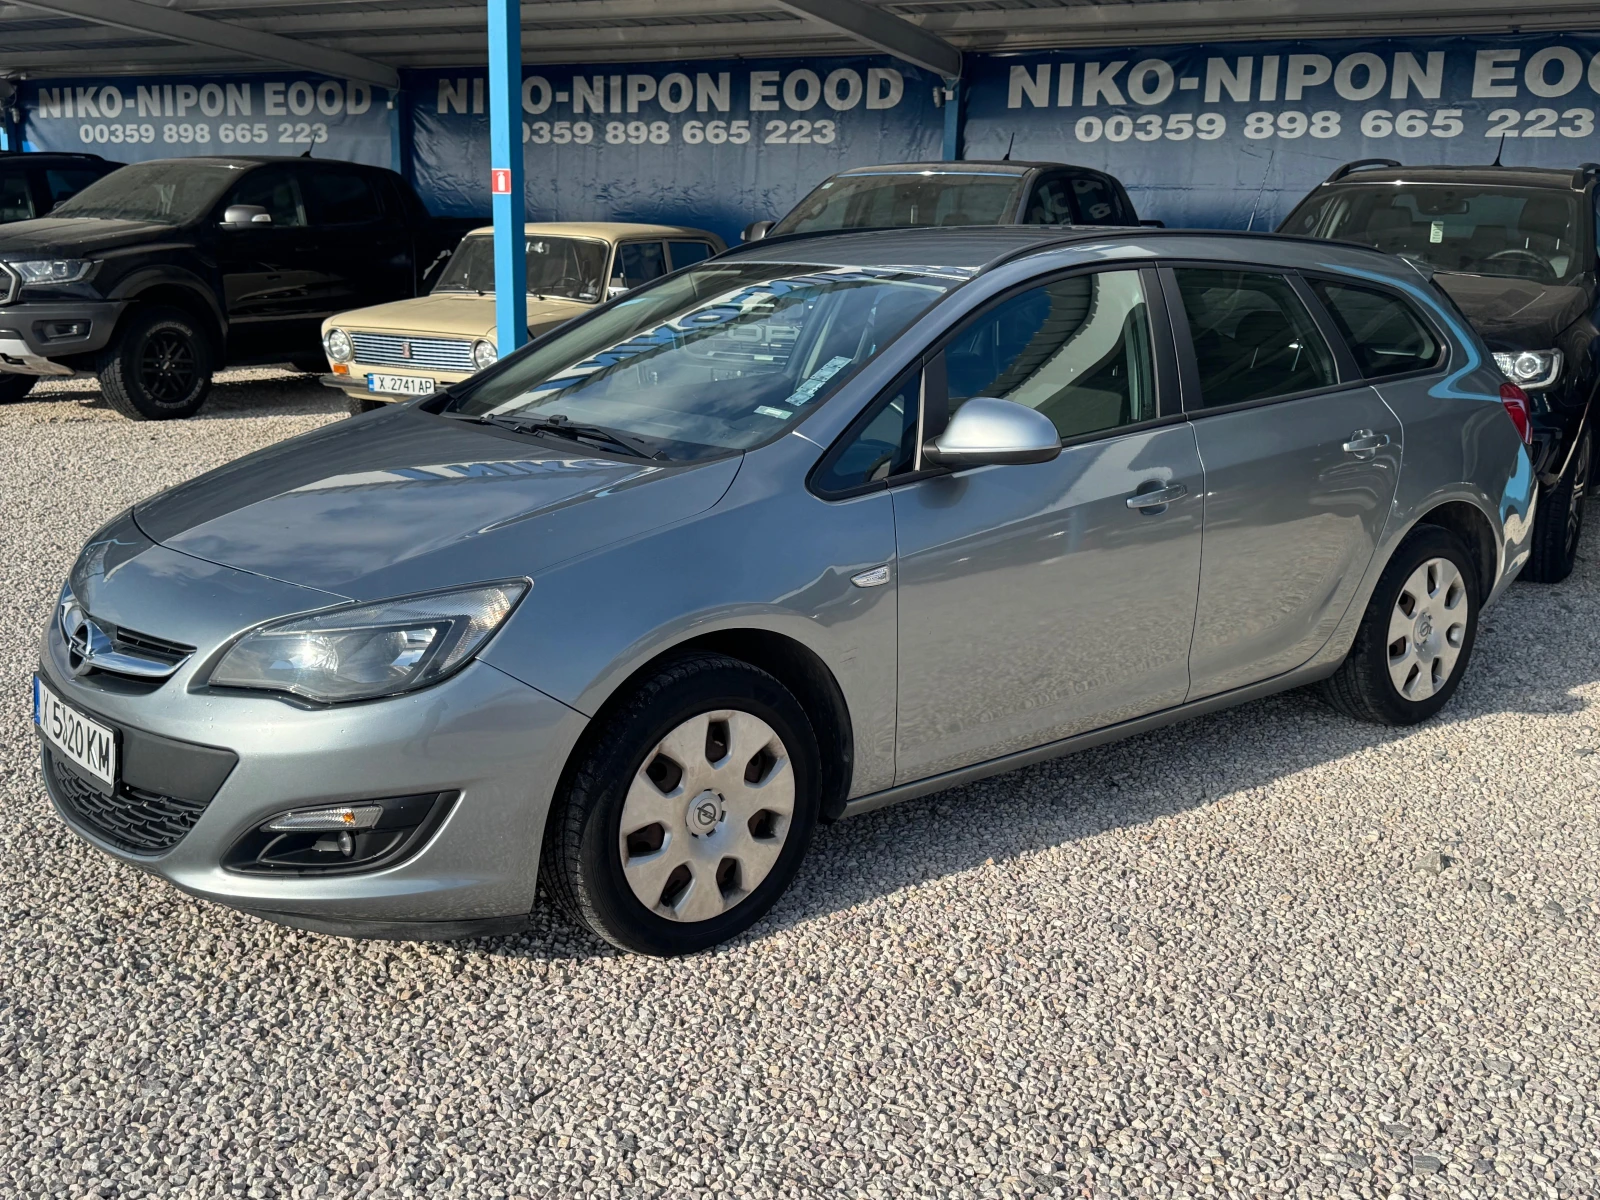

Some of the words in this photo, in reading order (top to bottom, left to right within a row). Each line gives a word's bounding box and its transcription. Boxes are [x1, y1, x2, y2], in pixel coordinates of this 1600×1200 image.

[437, 72, 731, 115] NIO-NIPON
[749, 67, 904, 111] EOOD
[1007, 51, 1445, 109] NIKO-NIPON
[1471, 46, 1600, 98] EO
[38, 83, 252, 119] NIKO-NIPON
[263, 80, 372, 116] EOOD
[79, 123, 156, 144] 00359
[163, 123, 211, 144] 898
[218, 123, 269, 144] 665
[277, 122, 329, 143] 223
[522, 121, 594, 145] 359
[604, 120, 671, 145] 898
[682, 119, 750, 145] 665
[764, 119, 836, 144] 223
[1074, 112, 1227, 143] 00359
[1243, 110, 1342, 140] 898
[1360, 108, 1464, 139] 665
[1484, 107, 1595, 138] 223
[379, 376, 386, 390] X
[390, 377, 416, 393] 2741
[418, 379, 432, 394] AP
[86, 725, 110, 777] KM
